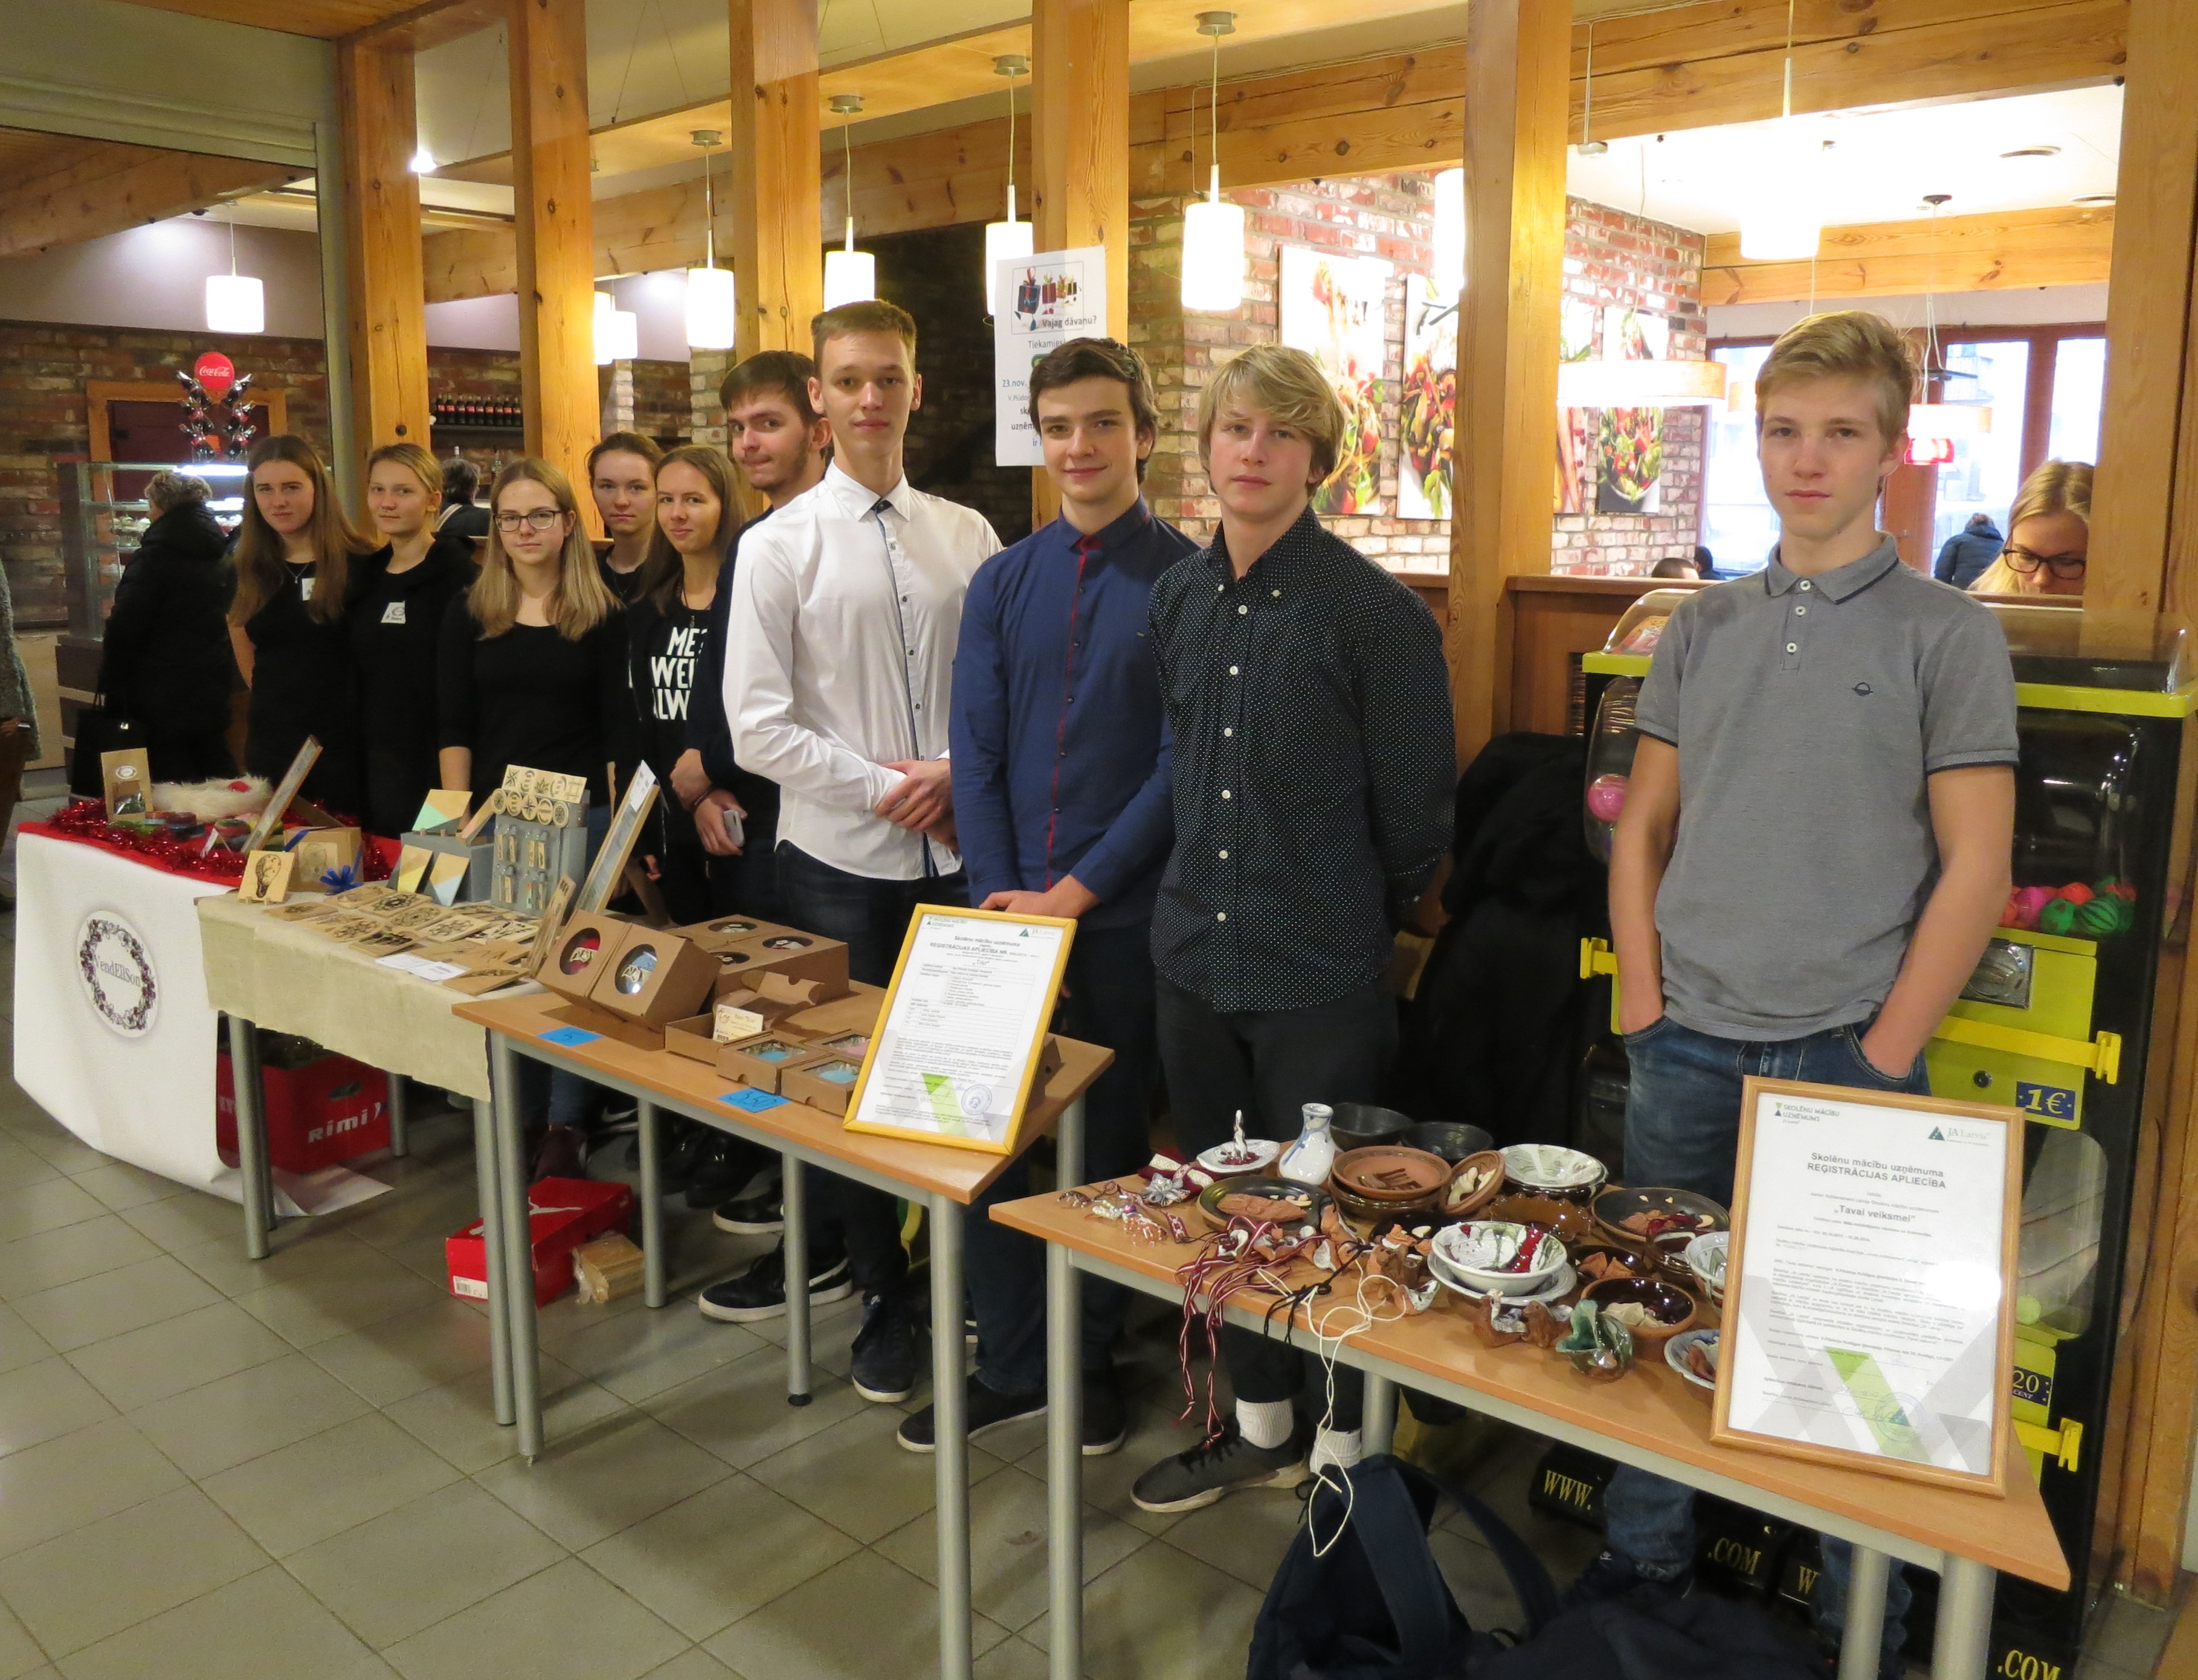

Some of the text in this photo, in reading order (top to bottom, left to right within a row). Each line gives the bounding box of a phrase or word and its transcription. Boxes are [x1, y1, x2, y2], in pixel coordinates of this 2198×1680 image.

[1042, 318, 1063, 329] Vajag
[1002, 379, 1027, 388] 23.nov.
[1011, 422, 1035, 432] uzņēm
[666, 626, 707, 657] ME
[1807, 1162, 1947, 1189] REĢISTRĀCIJAS APLIECĪBA
[1811, 1152, 1944, 1177] Skolēnu mācību uzņēmuma
[2013, 1369, 2040, 1394] 20
[2013, 1389, 2034, 1400] CENT
[1544, 1470, 1594, 1510] WWW.
[1707, 1538, 1761, 1575] .COM
